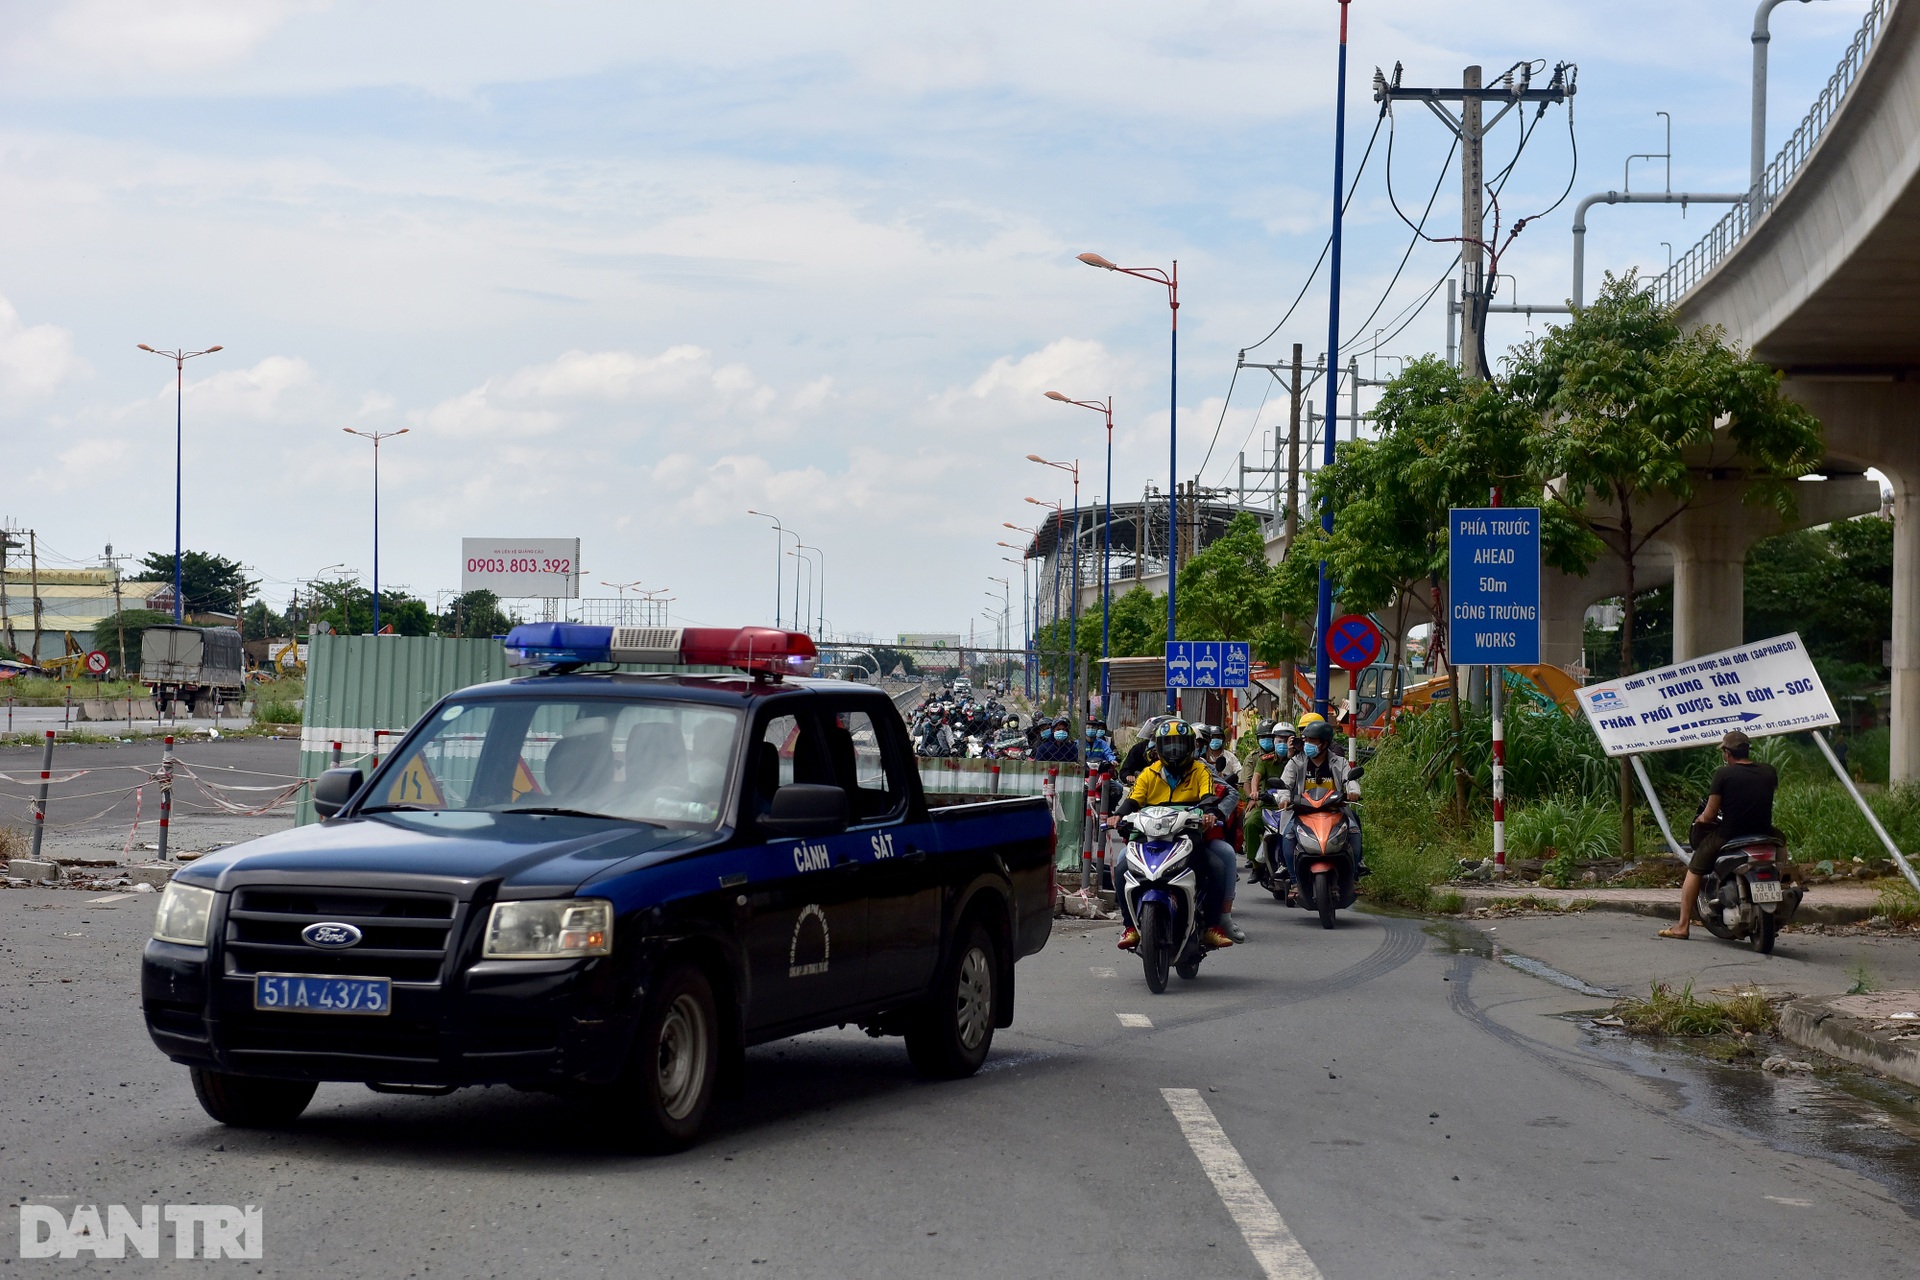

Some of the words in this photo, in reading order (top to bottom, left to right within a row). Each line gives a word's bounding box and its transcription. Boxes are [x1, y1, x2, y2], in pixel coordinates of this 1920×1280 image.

[1460, 517, 1487, 535] PHÍA
[1490, 517, 1530, 536] TRƯỚC
[1473, 548, 1515, 564] AHEAD
[467, 558, 570, 573] 0903.803.392
[1479, 577, 1507, 592] 50m
[1454, 602, 1485, 619] CÔNG
[1489, 602, 1536, 620] TRƯỜNG
[1475, 632, 1516, 648] WORKS
[1625, 679, 1645, 691] CÔNG
[1646, 677, 1656, 685] TY
[1658, 670, 1678, 682] TNHH
[1679, 665, 1697, 676] MTV
[1698, 659, 1718, 672] DƯỢC
[1720, 655, 1732, 667] SÀI
[1733, 652, 1749, 664] GÒN
[1751, 640, 1797, 660] (SAPHARCO)
[1658, 679, 1704, 699] TRUNG
[1709, 671, 1741, 687] TÂM
[1600, 715, 1636, 729] PHÂN
[1640, 704, 1673, 724] PHỐI
[1676, 697, 1713, 715] DƯỢC
[1718, 691, 1742, 707] SÀI
[1746, 687, 1775, 703] GÒN
[1785, 678, 1814, 695] SDC
[1701, 730, 1721, 739] QUẬN
[793, 840, 830, 872] CẢNH
[871, 829, 894, 860] SÁT
[314, 926, 348, 942] Ford
